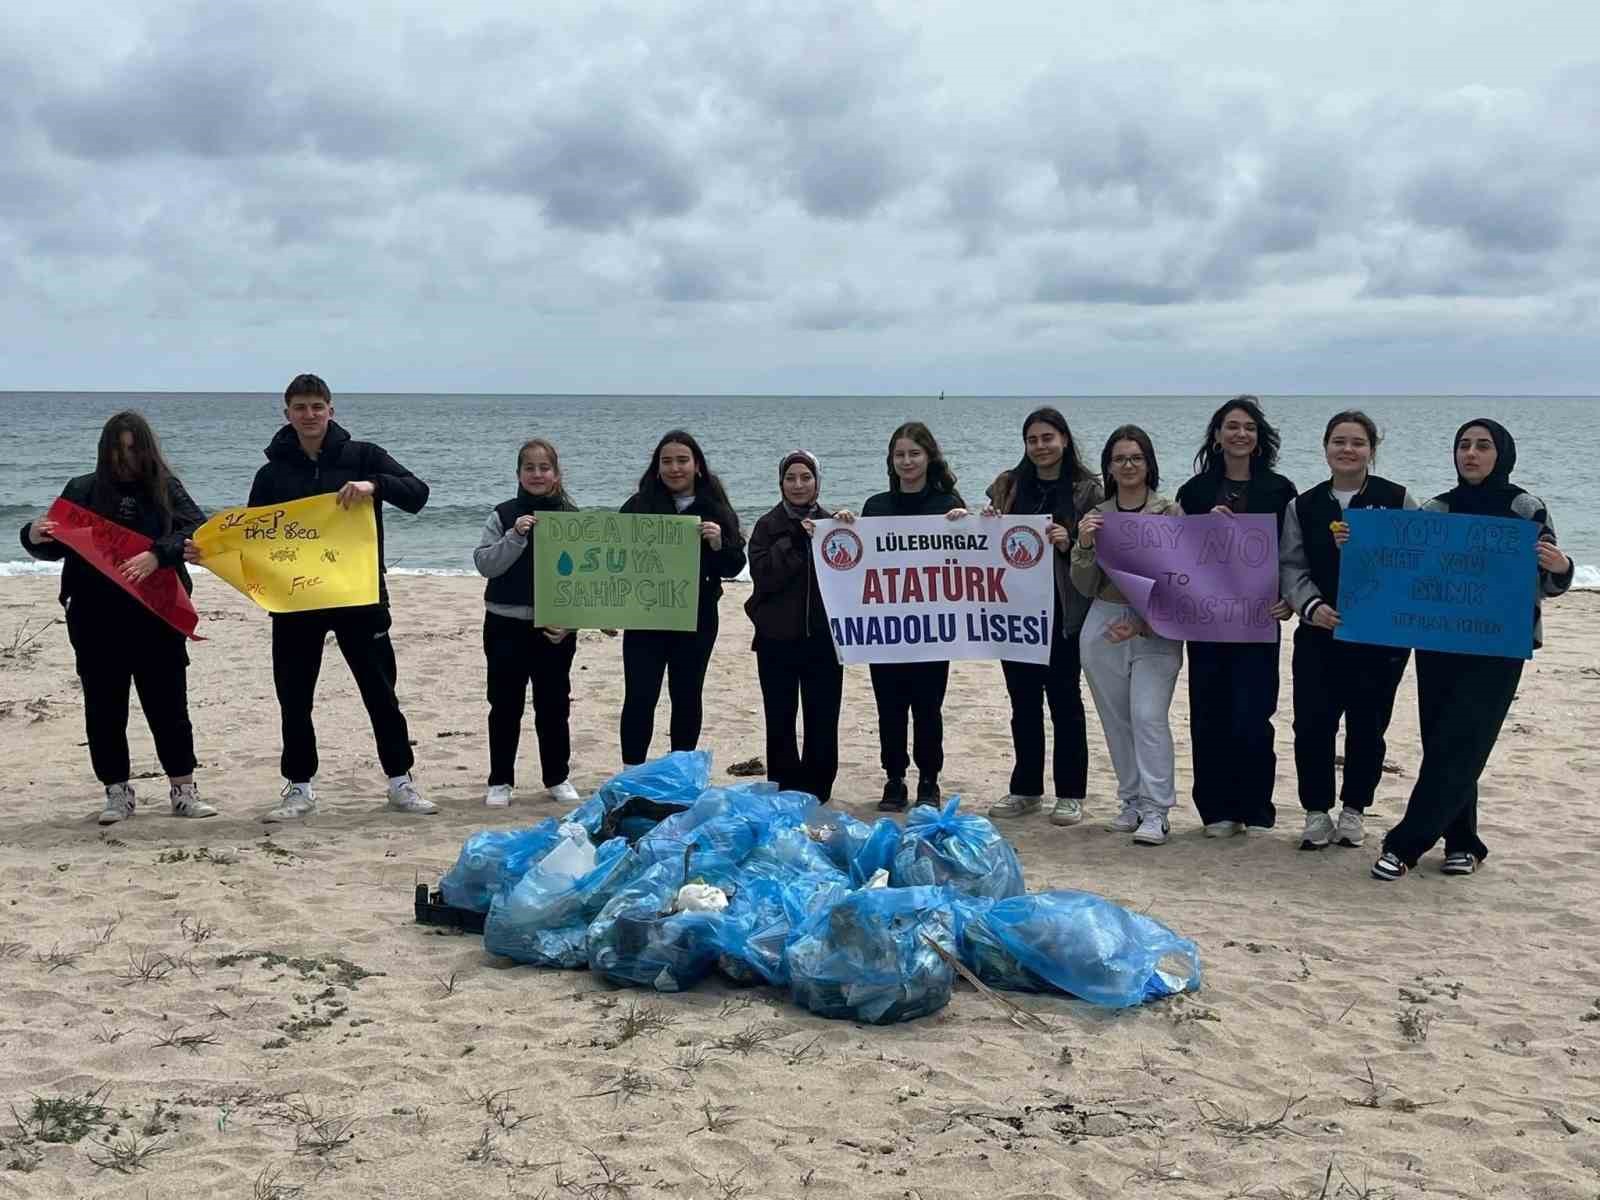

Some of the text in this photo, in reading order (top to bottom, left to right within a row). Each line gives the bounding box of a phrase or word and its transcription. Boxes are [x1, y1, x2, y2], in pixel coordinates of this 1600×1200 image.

[244, 526, 277, 541] the
[546, 516, 622, 543] DOĞA
[876, 532, 989, 552] LÜLEBURGAZ
[1119, 519, 1271, 568] SAY NO
[862, 558, 1008, 604] ATATÜRK
[1165, 571, 1190, 586] TO
[830, 608, 1048, 646] ANADOLU LİSESİ
